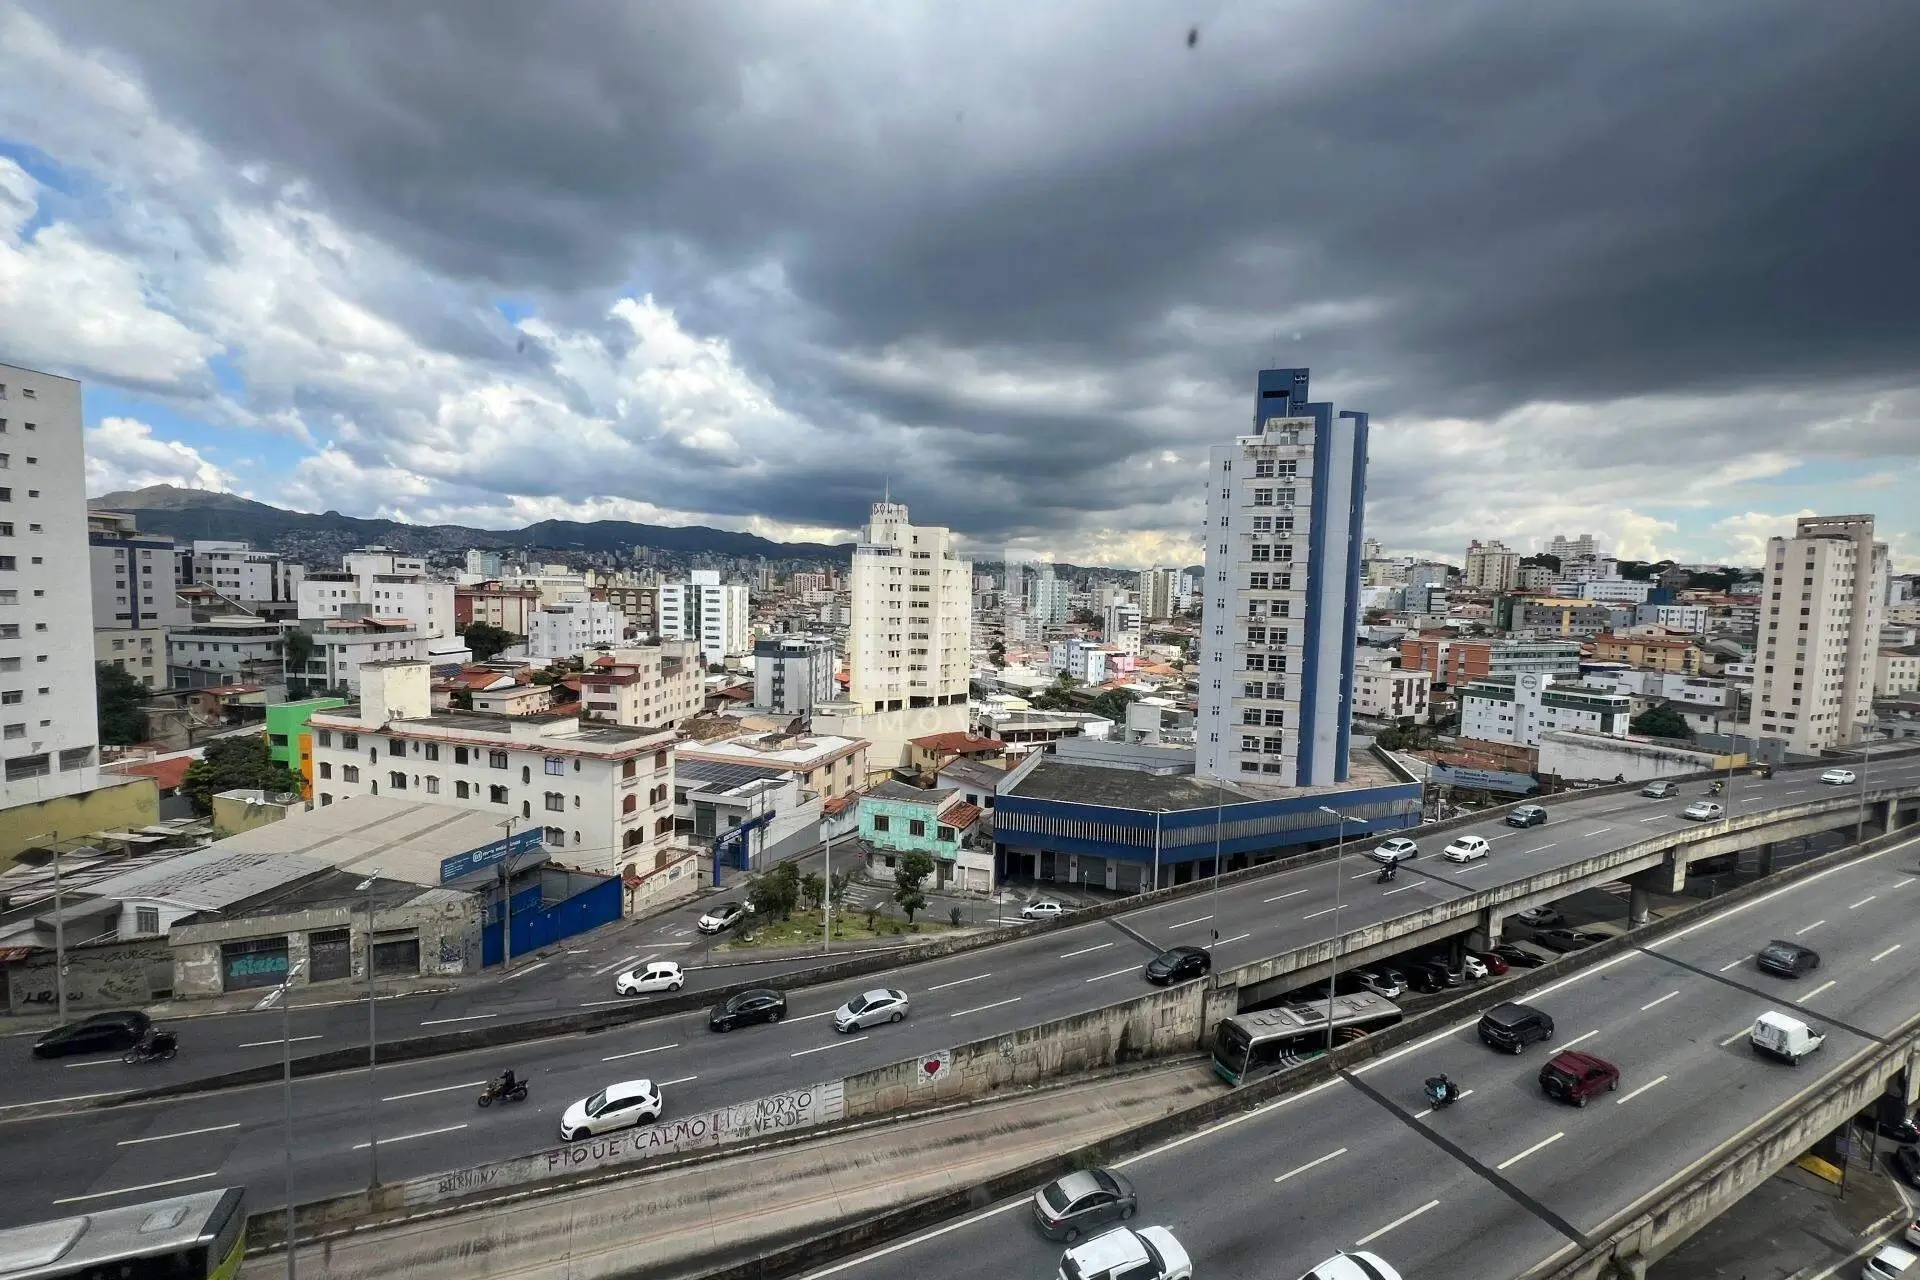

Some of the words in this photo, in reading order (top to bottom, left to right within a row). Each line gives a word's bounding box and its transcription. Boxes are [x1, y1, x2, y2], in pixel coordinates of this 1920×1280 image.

[755, 1092, 812, 1118] MORRO
[754, 1108, 809, 1133] VERDE
[547, 1140, 621, 1173] FIQUE
